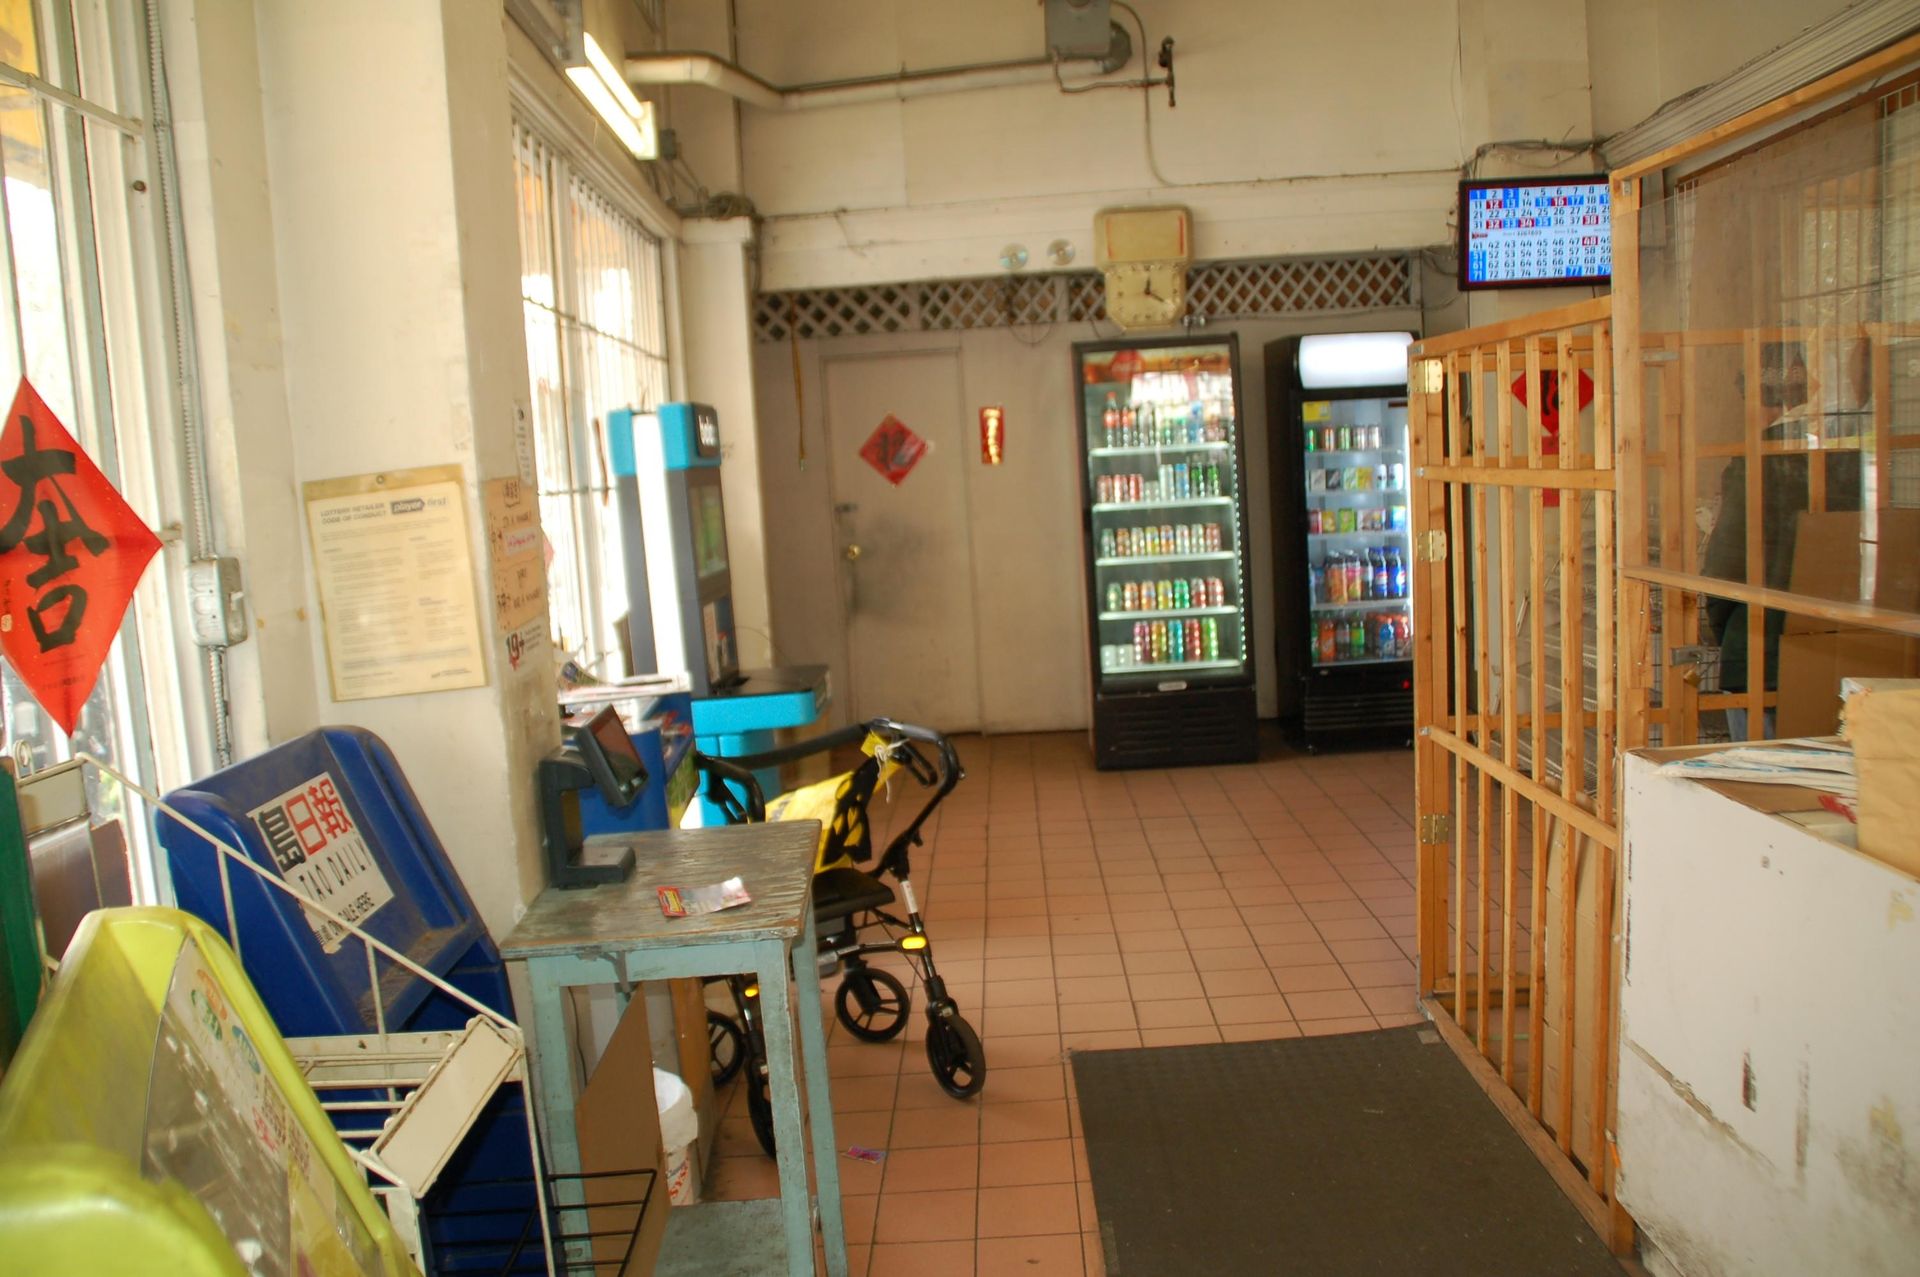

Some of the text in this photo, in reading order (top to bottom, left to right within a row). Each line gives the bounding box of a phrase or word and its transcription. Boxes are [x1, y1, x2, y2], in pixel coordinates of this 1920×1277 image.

[1587, 195, 1596, 203] 18
[1522, 268, 1530, 276] 74
[1538, 267, 1546, 275] 75
[0, 414, 111, 653] 大吉
[298, 838, 373, 902] TAO DAILY
